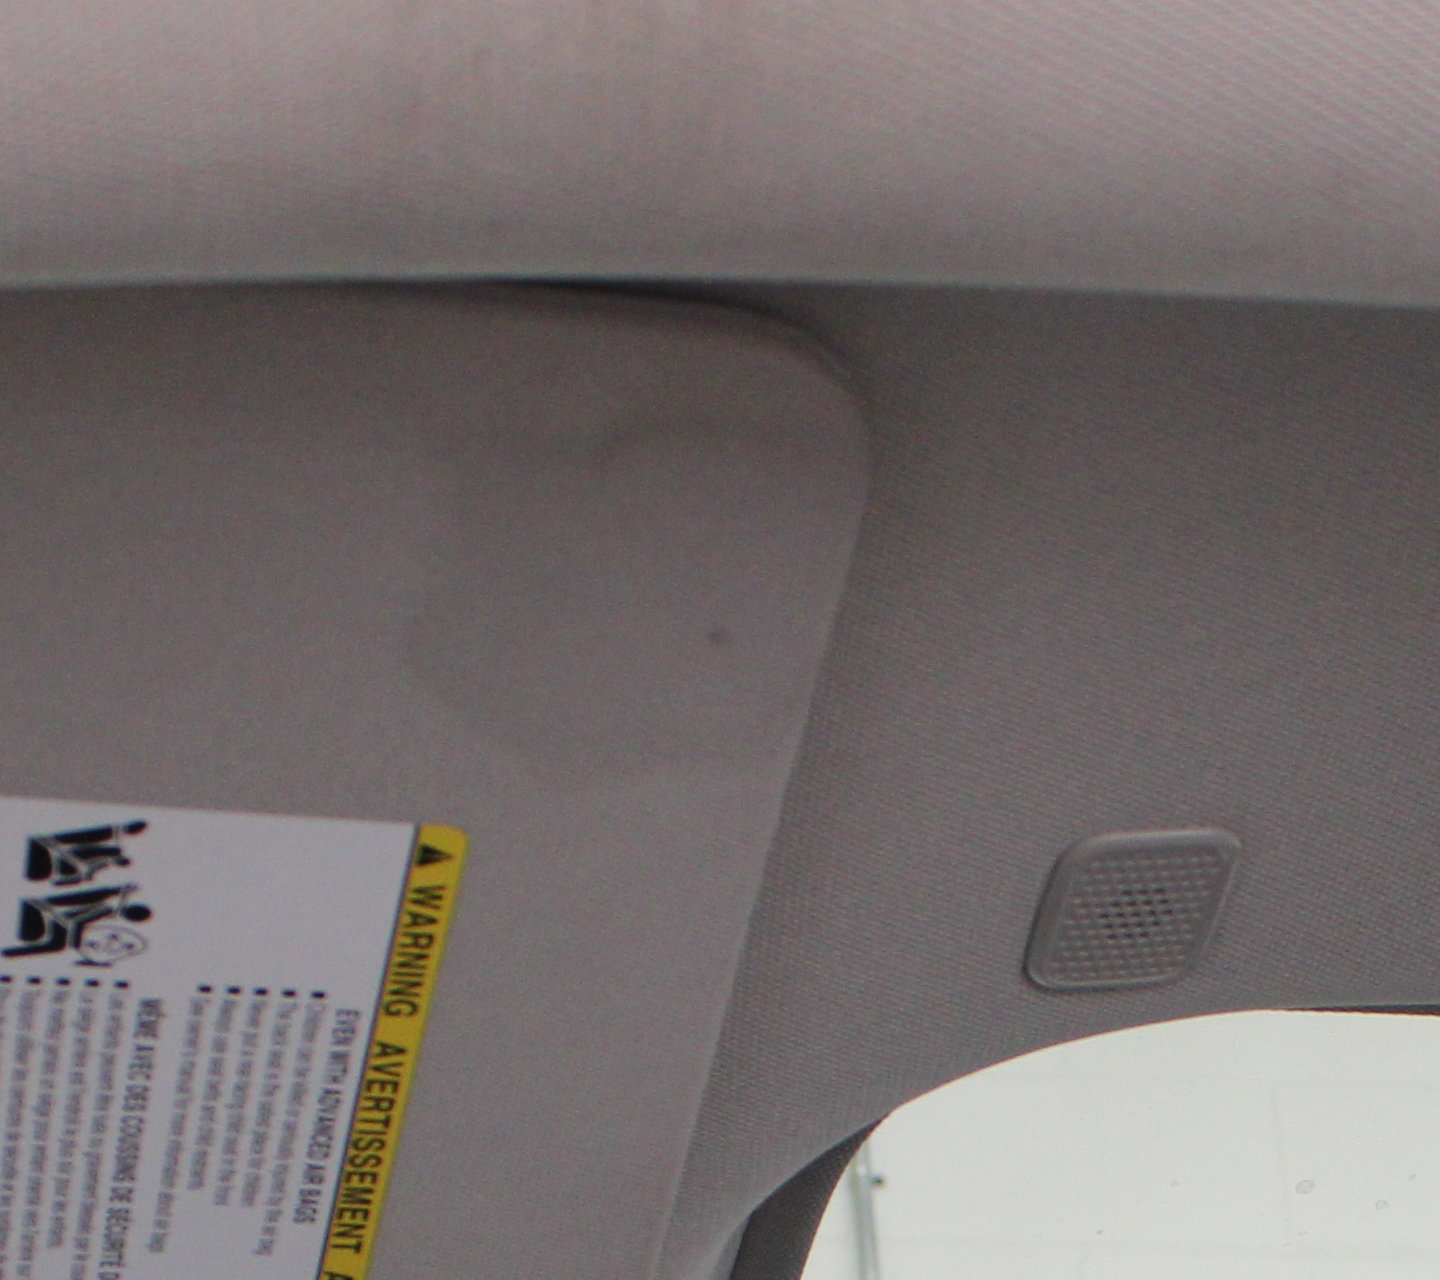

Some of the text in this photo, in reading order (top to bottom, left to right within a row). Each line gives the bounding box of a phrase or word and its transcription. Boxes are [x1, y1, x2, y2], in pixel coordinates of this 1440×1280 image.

[382, 884, 444, 1017] WARNING
[293, 1008, 359, 1223] EVEN WITH ADVANCED AIR BAGS
[329, 1040, 407, 1252] AVERTISSEMENT
